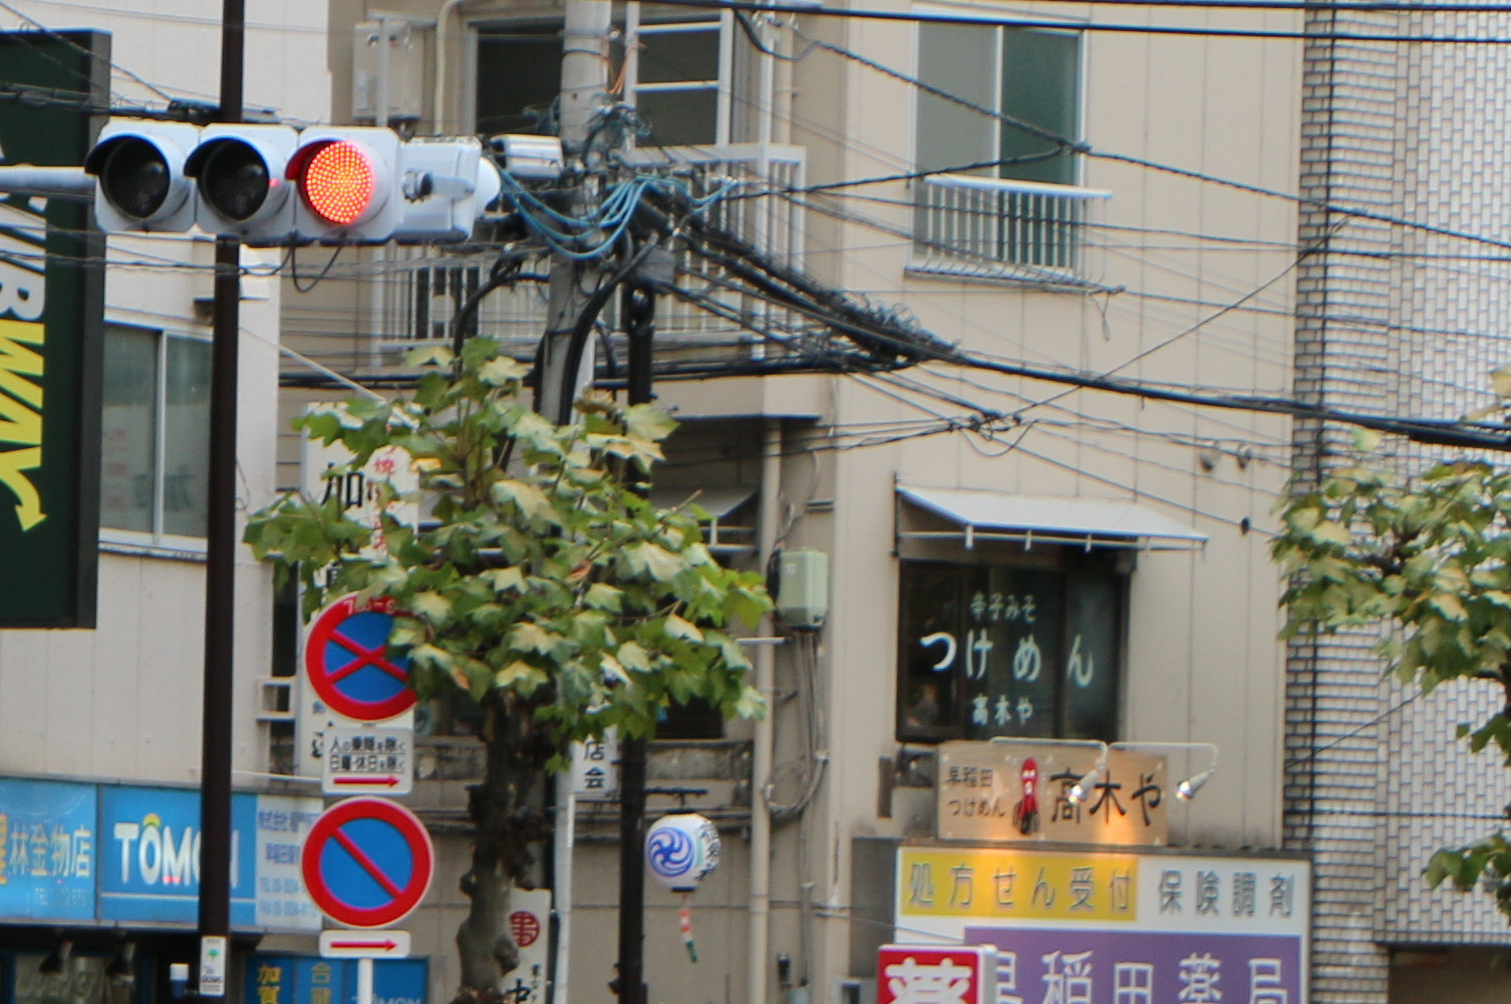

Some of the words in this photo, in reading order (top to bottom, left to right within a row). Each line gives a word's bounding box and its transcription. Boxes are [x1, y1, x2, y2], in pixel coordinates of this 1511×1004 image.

[920, 628, 1093, 687] つけめん
[972, 693, 1033, 726] 高木や
[585, 740, 605, 788] 店会
[946, 766, 993, 787] 早稲田
[1050, 767, 1163, 826] 高木や
[948, 799, 1005, 817] つけめん
[908, 860, 1133, 912] 処方せん受付
[1158, 869, 1295, 918] 保険調剤
